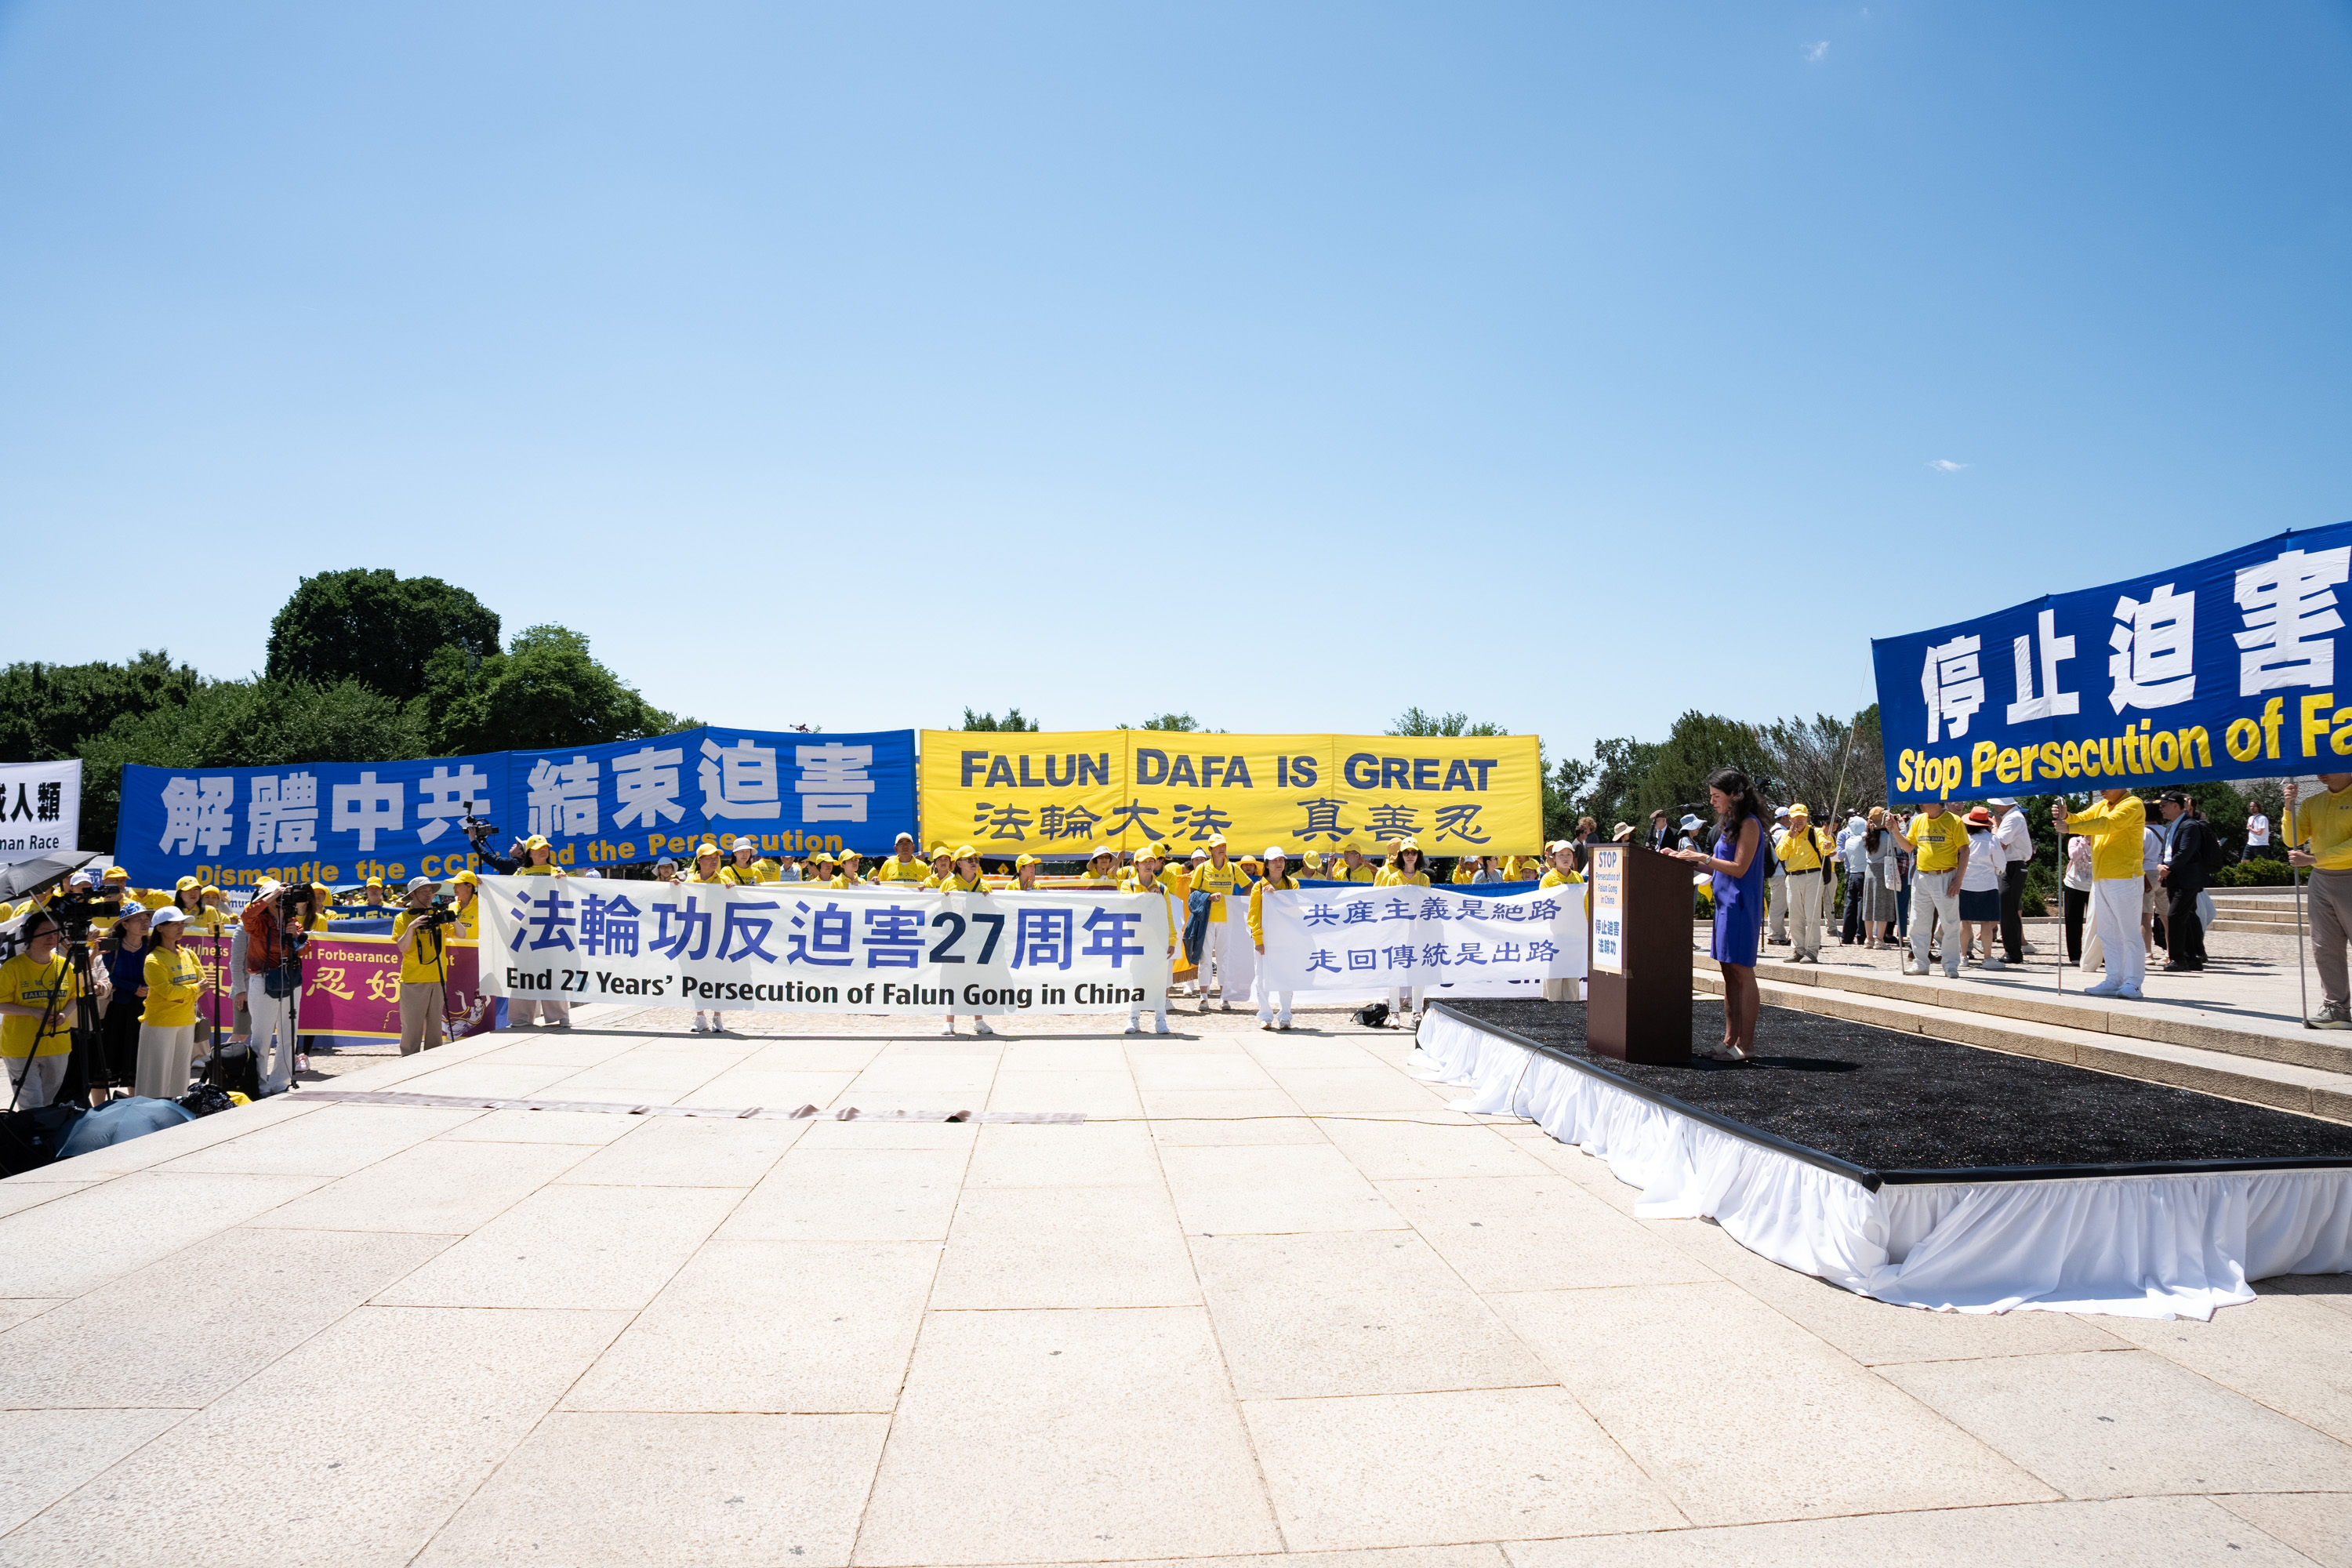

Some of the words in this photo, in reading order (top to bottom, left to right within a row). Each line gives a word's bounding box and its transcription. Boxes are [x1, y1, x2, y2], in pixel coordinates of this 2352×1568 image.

[1921, 546, 2352, 744] 停止迫害
[1896, 749, 1962, 800] Stop
[1972, 718, 2212, 787] Persecution
[2225, 696, 2284, 762] of
[960, 750, 1109, 788] FALUN
[1136, 748, 1253, 788] DAFA
[1277, 755, 1318, 788] IS
[1344, 753, 1497, 792] GREAT
[973, 798, 1232, 841] 法輪大法
[1292, 797, 1492, 844] 真善忍
[30, 835, 60, 850] Race
[196, 861, 339, 887] Dismantle
[355, 859, 406, 880] the
[587, 840, 636, 862] the
[648, 829, 844, 855] Persecution
[1599, 851, 1617, 868] STOP
[510, 889, 1145, 972] 法輪功反迫害27周年
[1595, 919, 1620, 937] 停止迫害
[1599, 938, 1617, 956] 法輪功
[317, 949, 398, 964] Forbearance
[1305, 939, 1560, 973] 走回傳統是出路
[506, 967, 552, 990] End
[561, 969, 589, 993] 27
[682, 976, 838, 1003] Persecution
[847, 982, 875, 1004] of
[883, 983, 955, 1005] Falun
[963, 983, 1033, 1009] Gong
[1042, 983, 1065, 1005] in
[1074, 983, 1145, 1004] China
